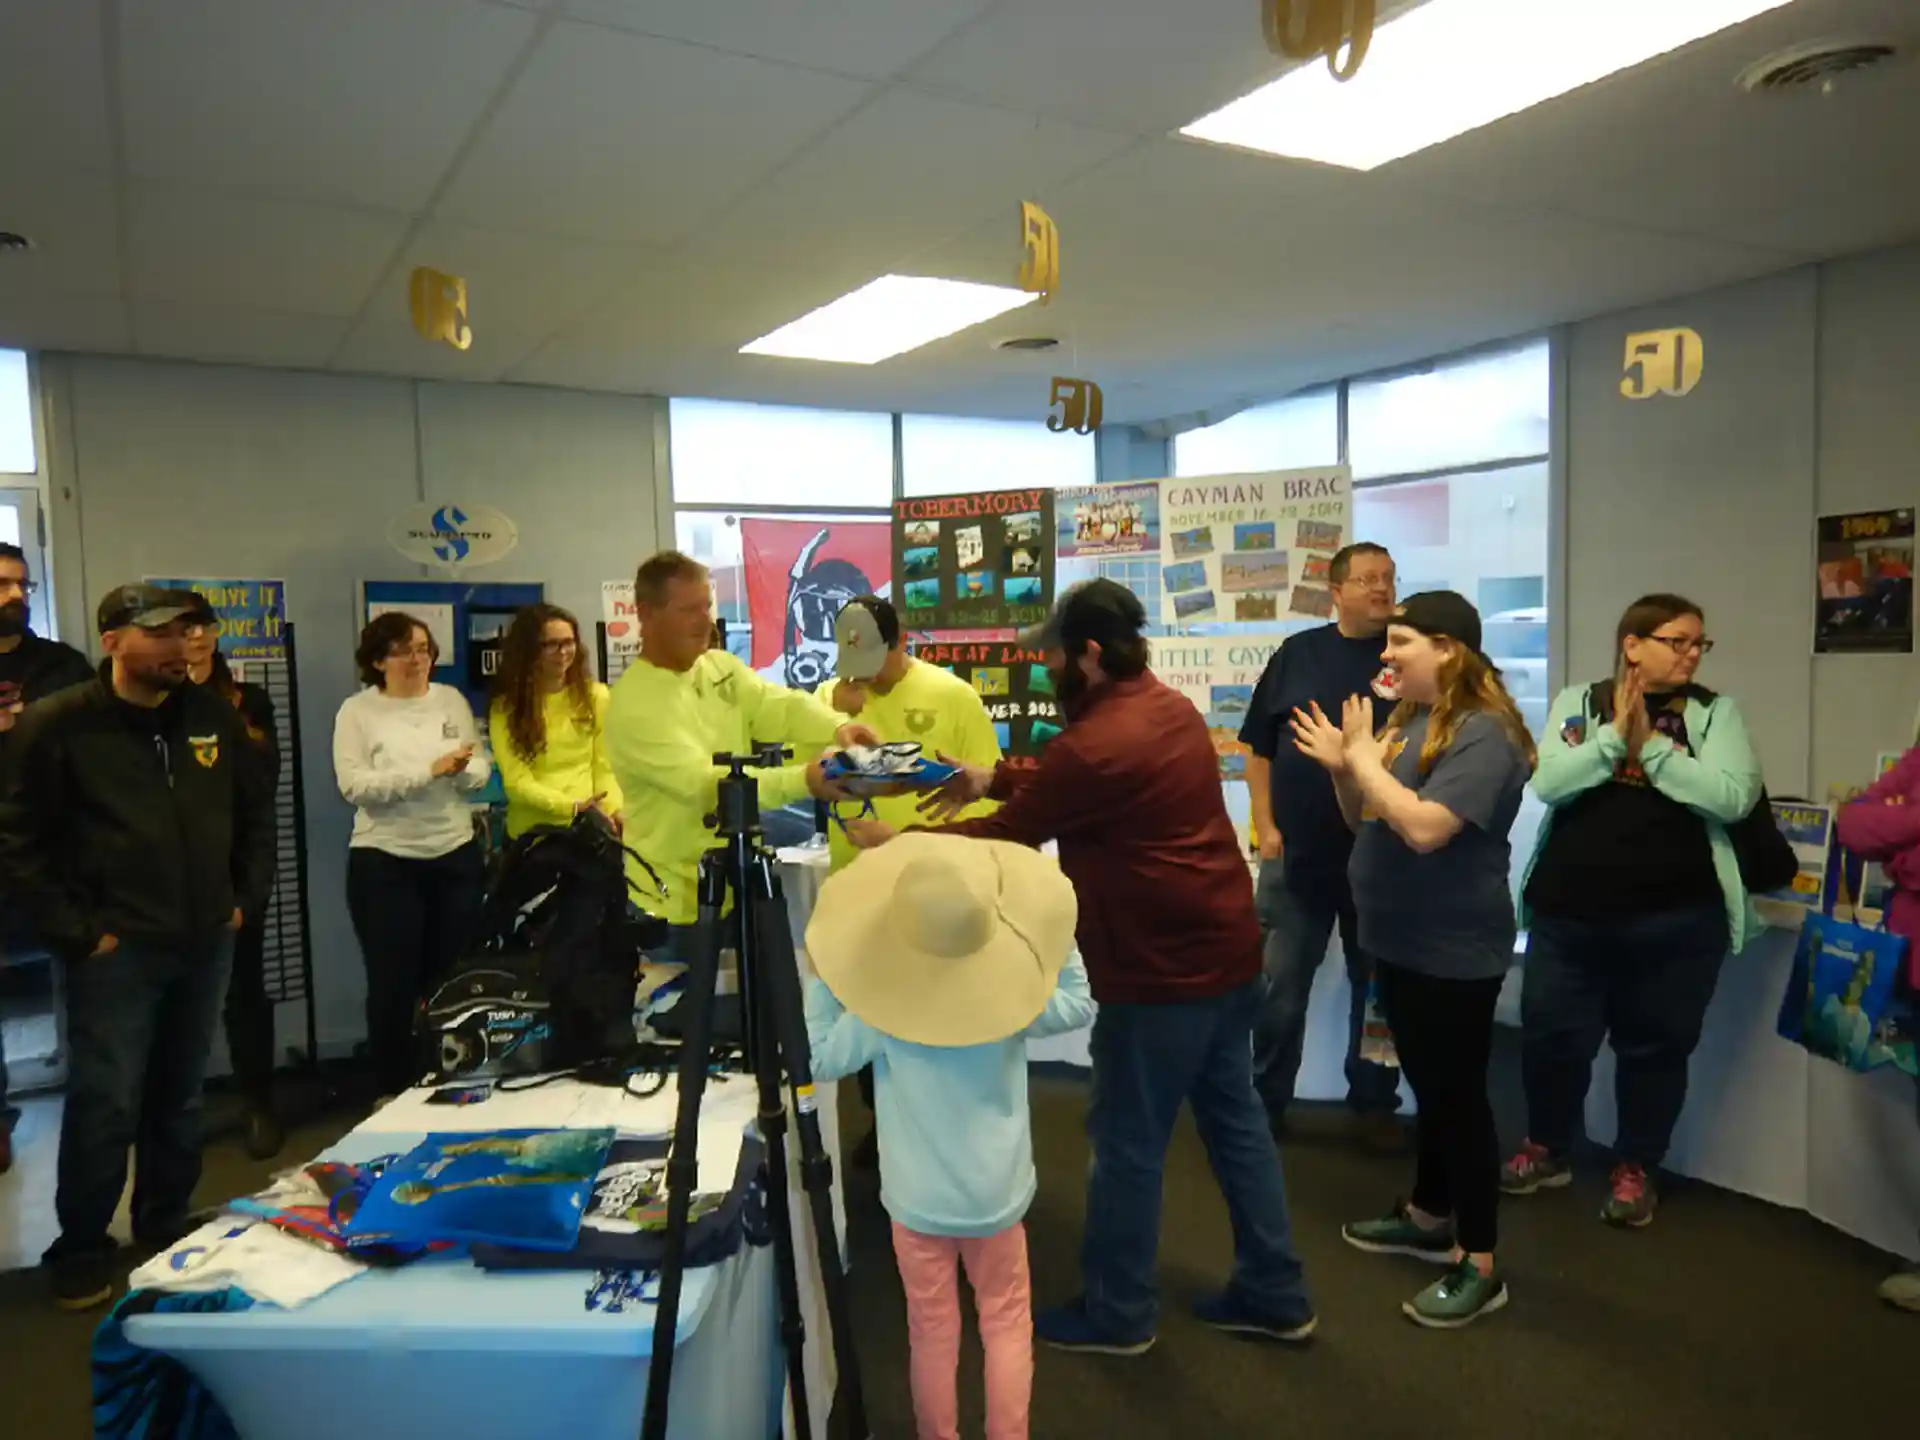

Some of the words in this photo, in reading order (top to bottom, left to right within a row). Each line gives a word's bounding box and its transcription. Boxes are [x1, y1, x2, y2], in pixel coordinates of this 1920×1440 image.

[1620, 327, 1703, 399] 50
[1046, 376, 1103, 435] 50
[1168, 484, 1264, 505] CAYMAN
[1284, 476, 1344, 500] BRAC
[920, 645, 991, 662] GREAT
